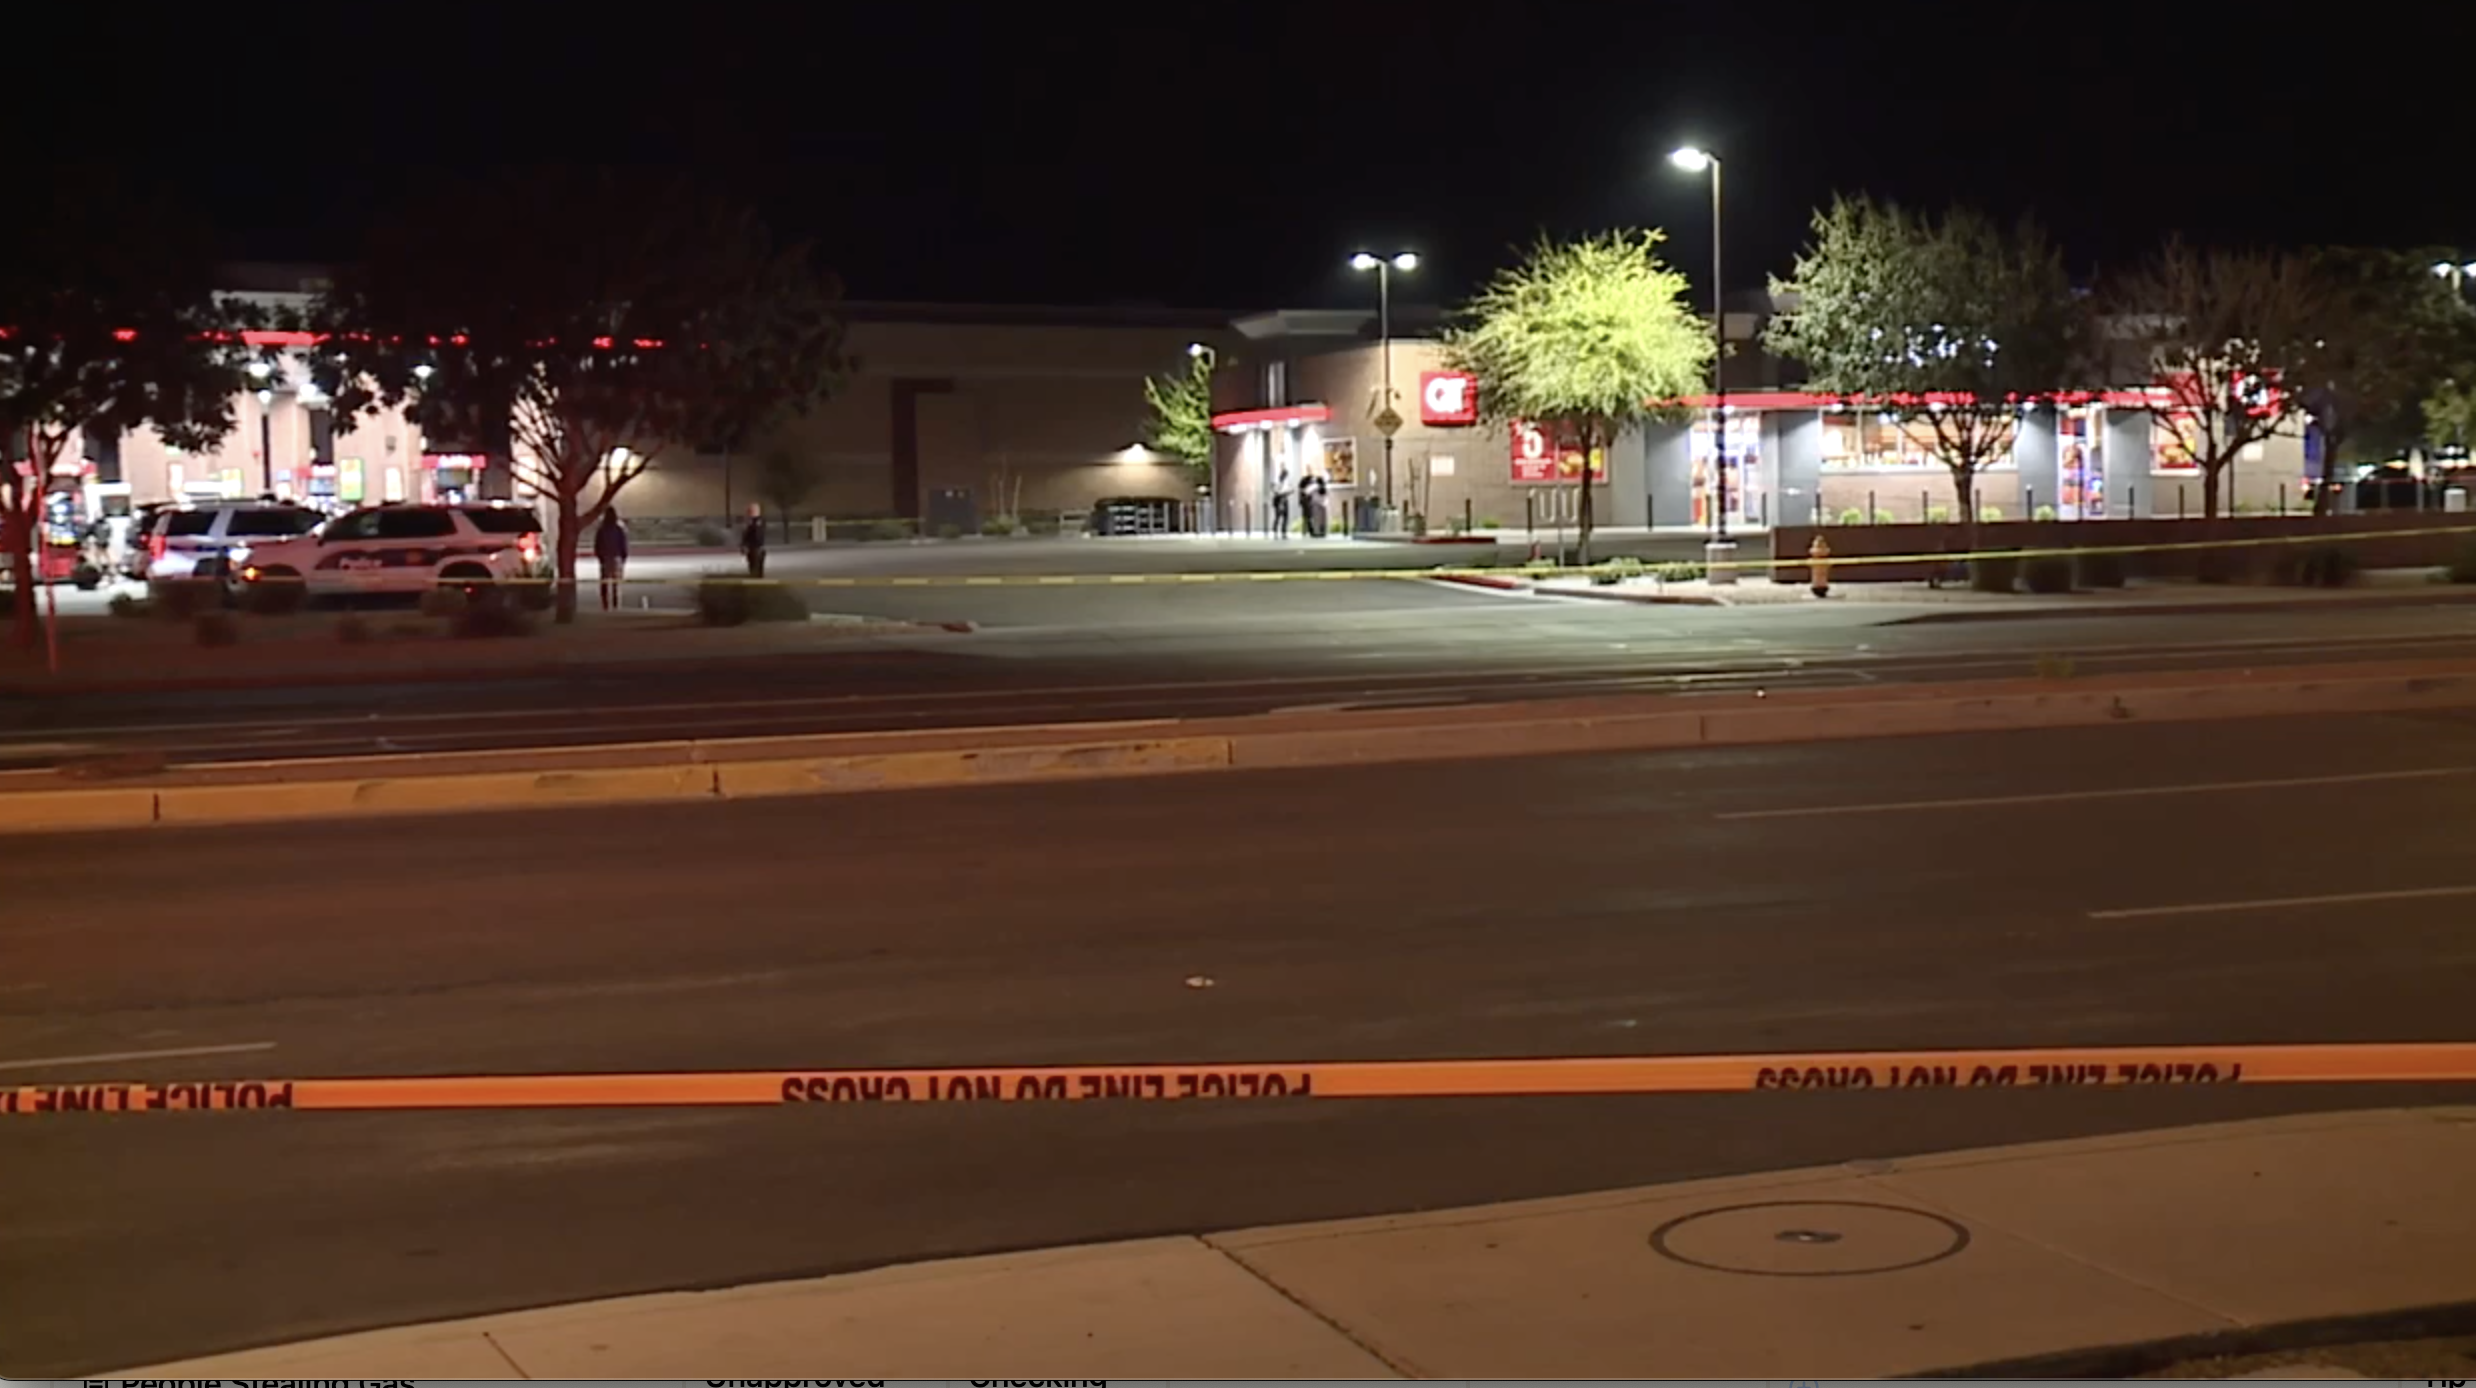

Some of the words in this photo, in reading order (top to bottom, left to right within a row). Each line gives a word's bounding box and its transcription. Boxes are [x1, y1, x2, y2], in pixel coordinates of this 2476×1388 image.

[146, 1083, 293, 1109] POLICE
[781, 1076, 911, 1101] CROSS
[929, 1075, 1001, 1100] NOT
[1015, 1075, 1067, 1100] DO
[1080, 1074, 1165, 1099] LINE
[1176, 1073, 1311, 1098] POLICE
[35, 1087, 131, 1112] LINE
